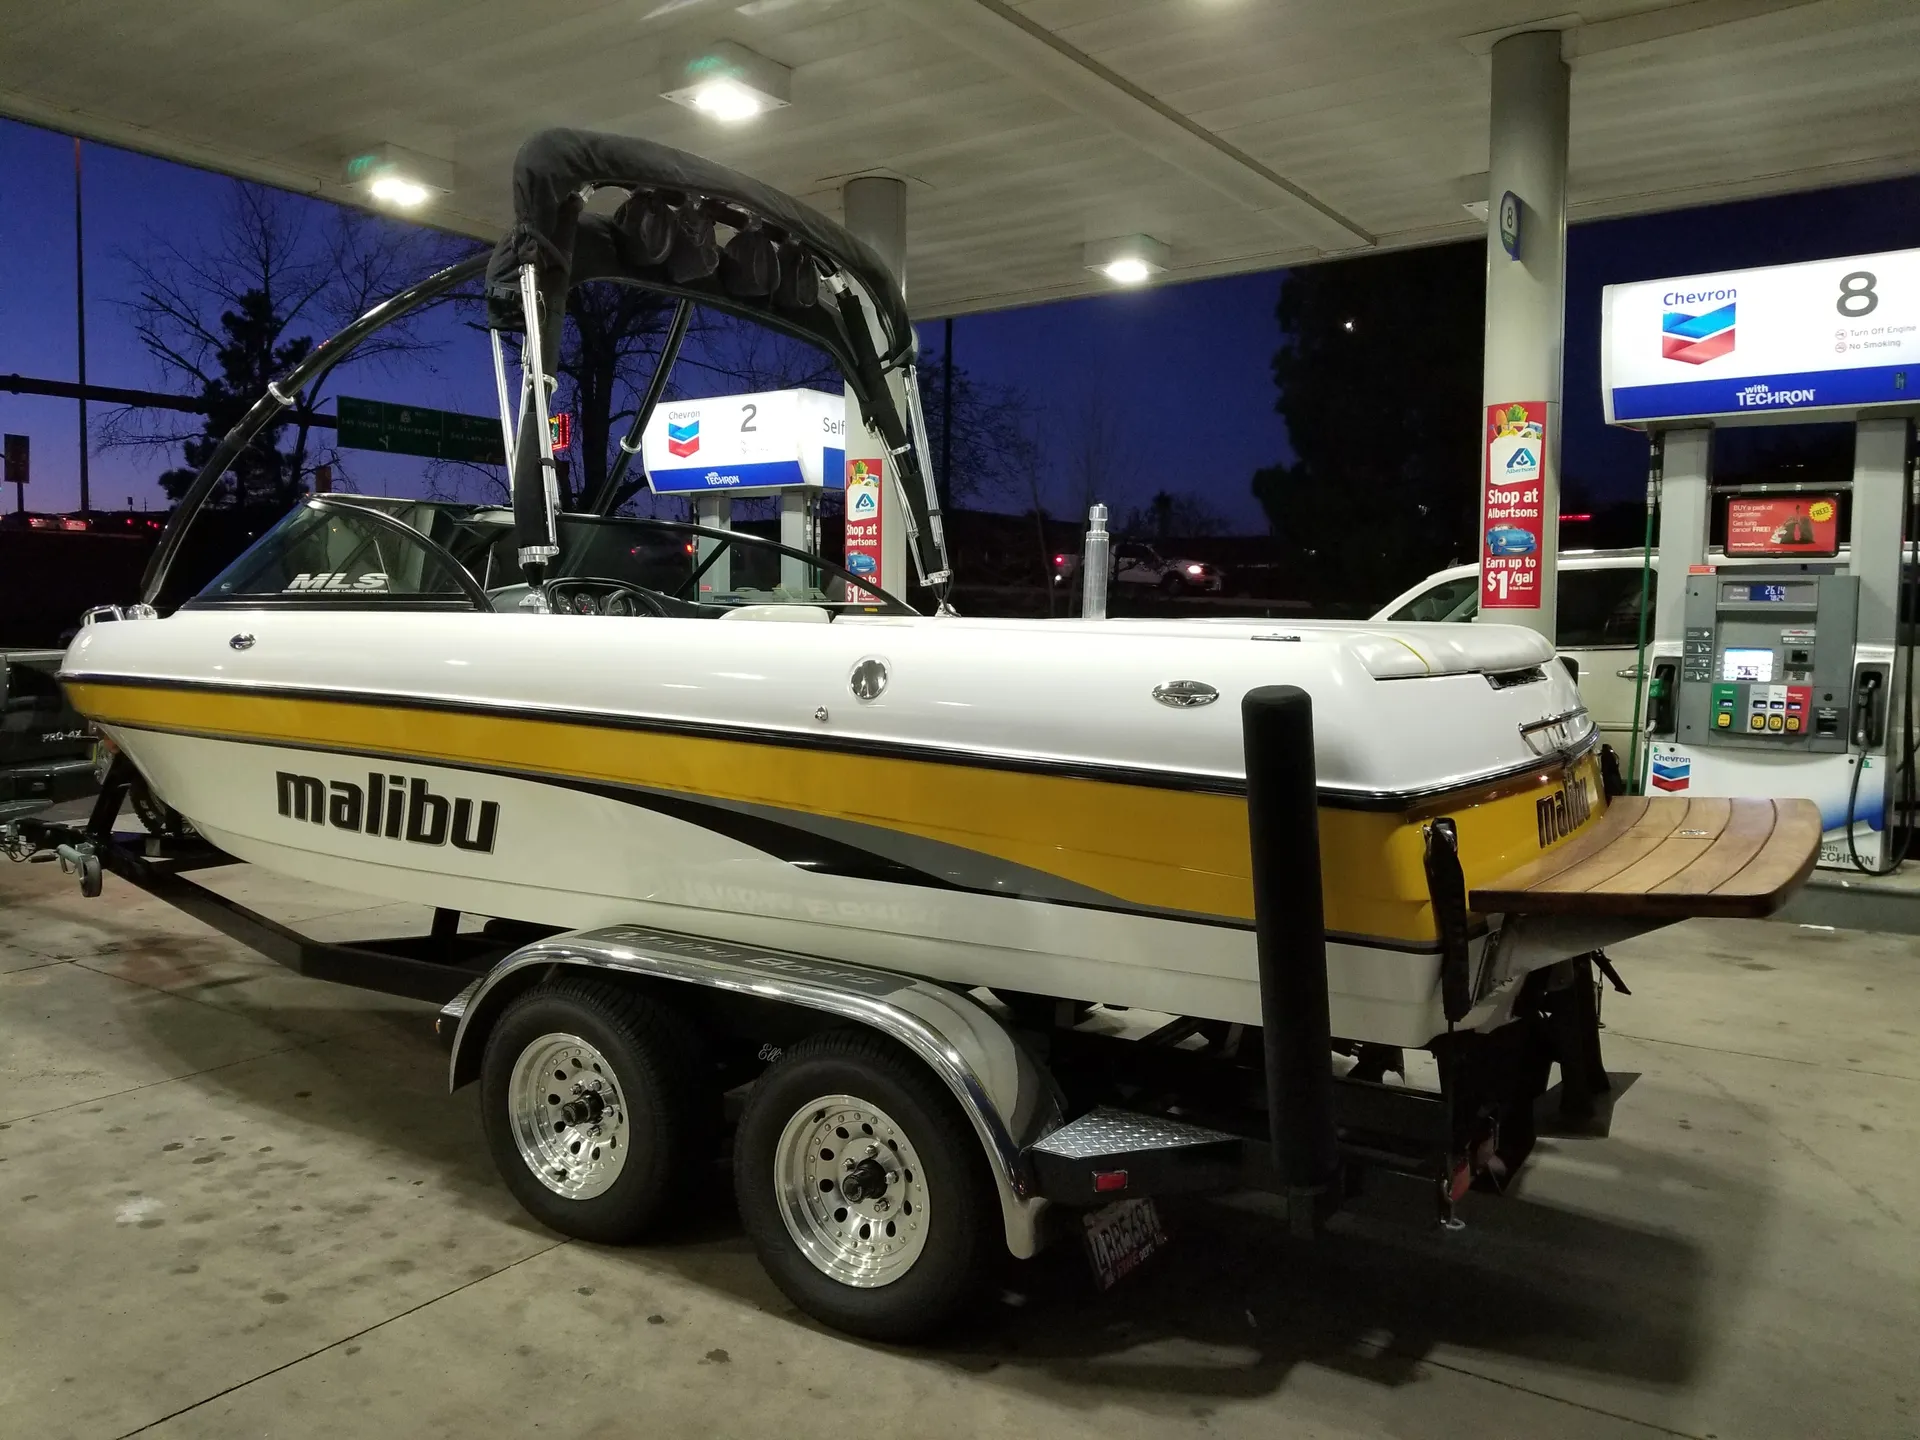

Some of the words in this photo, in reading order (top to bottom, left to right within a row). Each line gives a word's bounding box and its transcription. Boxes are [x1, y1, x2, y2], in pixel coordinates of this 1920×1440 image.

[1507, 206, 1513, 229] 8
[1663, 288, 1737, 306] Chevron
[1836, 271, 1879, 318] 8
[1850, 329, 1869, 337] Turn
[1871, 327, 1884, 335] Off
[1887, 324, 1917, 335] Engine
[1863, 339, 1902, 349] Smoking
[1744, 384, 1769, 394] with
[1736, 389, 1815, 406] TECHRON
[668, 410, 701, 420] Chevron
[740, 403, 758, 432] 2
[823, 417, 845, 436] Self
[705, 475, 740, 486] TECHRON
[1488, 489, 1520, 506] Shop
[1523, 488, 1539, 503] at
[1488, 507, 1538, 519] Albertsons
[847, 524, 864, 538] Shop
[866, 523, 877, 535] at
[1486, 557, 1506, 569] Earn
[1509, 559, 1522, 570] up
[1525, 556, 1536, 568] to
[288, 573, 389, 589] MLS
[1487, 570, 1508, 599] $1
[1509, 571, 1533, 585] /gal
[1765, 586, 1786, 595] 26.14
[41, 730, 82, 742] PRO-4X
[1654, 754, 1691, 763] Chevron
[276, 770, 501, 855] malibu
[1820, 852, 1874, 866] ECHRON
[601, 931, 741, 959] Malibu
[744, 957, 886, 985] Boats
